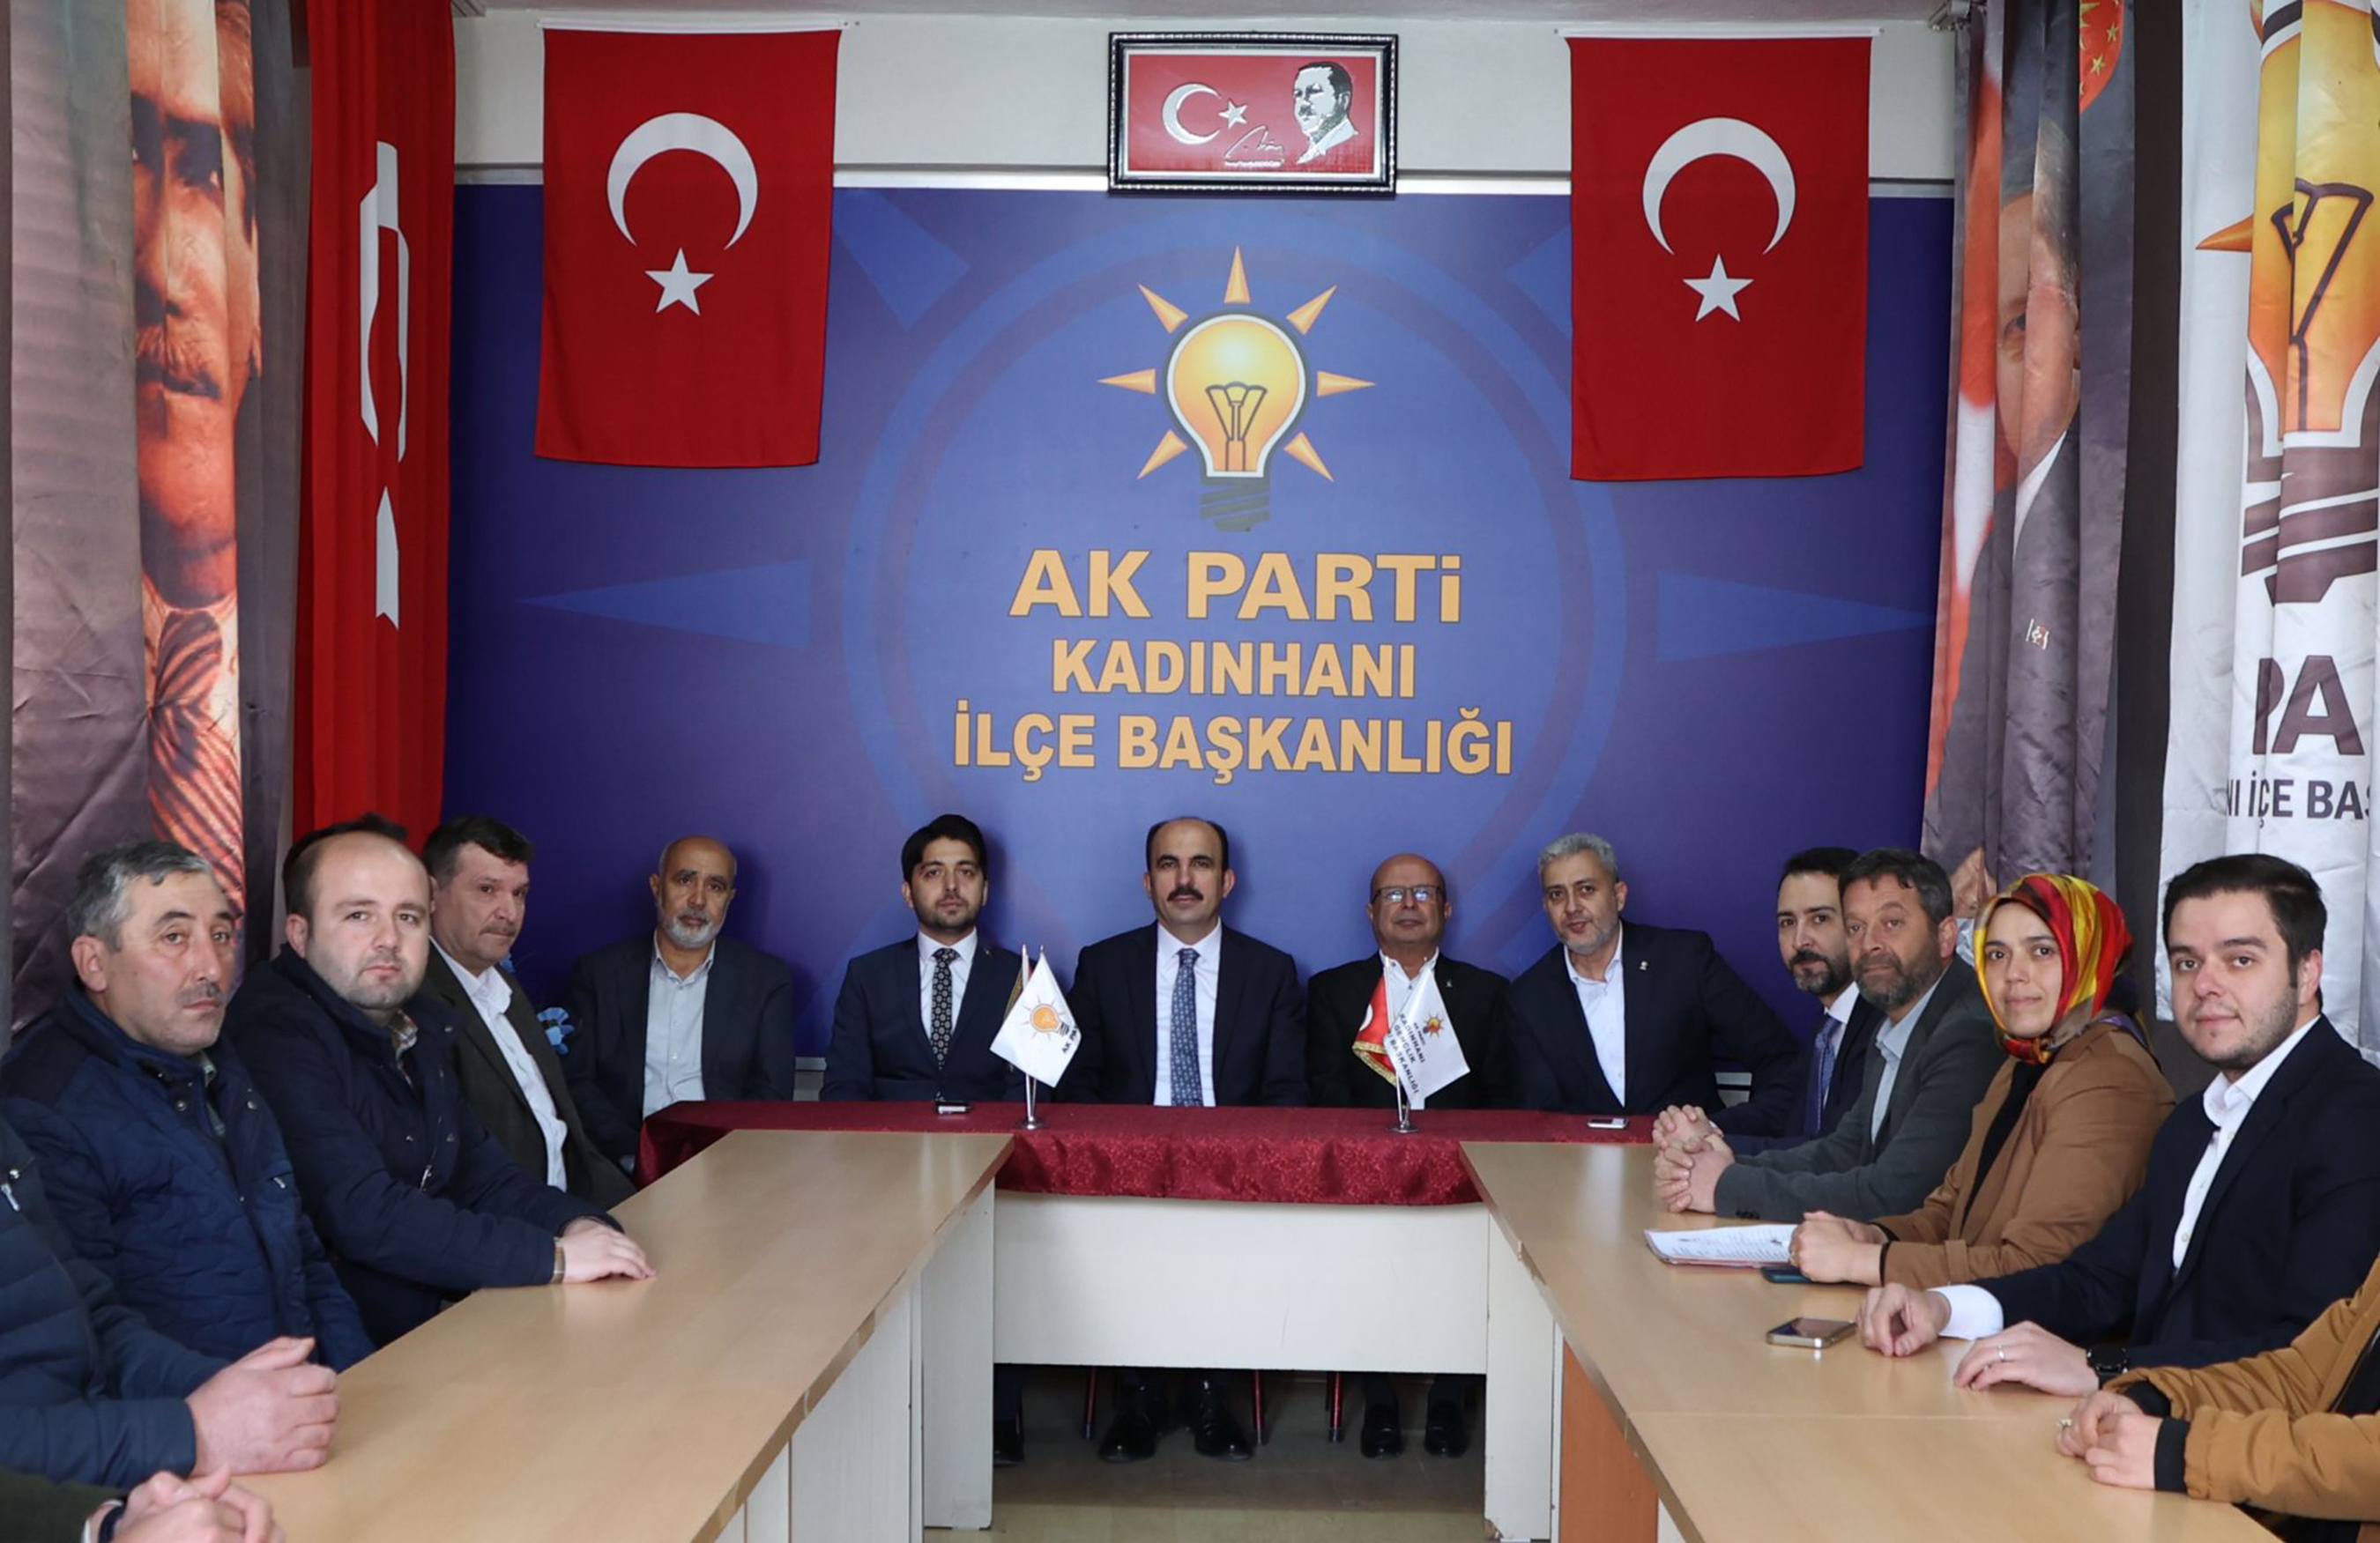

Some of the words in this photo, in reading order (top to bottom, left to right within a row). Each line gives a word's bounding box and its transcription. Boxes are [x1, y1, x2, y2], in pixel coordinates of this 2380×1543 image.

[1008, 548, 1153, 618] AK
[1052, 639, 1416, 699] KADINHANI
[954, 699, 1097, 783] İLÇE
[1119, 706, 1514, 785] BAŞKANLIĞI
